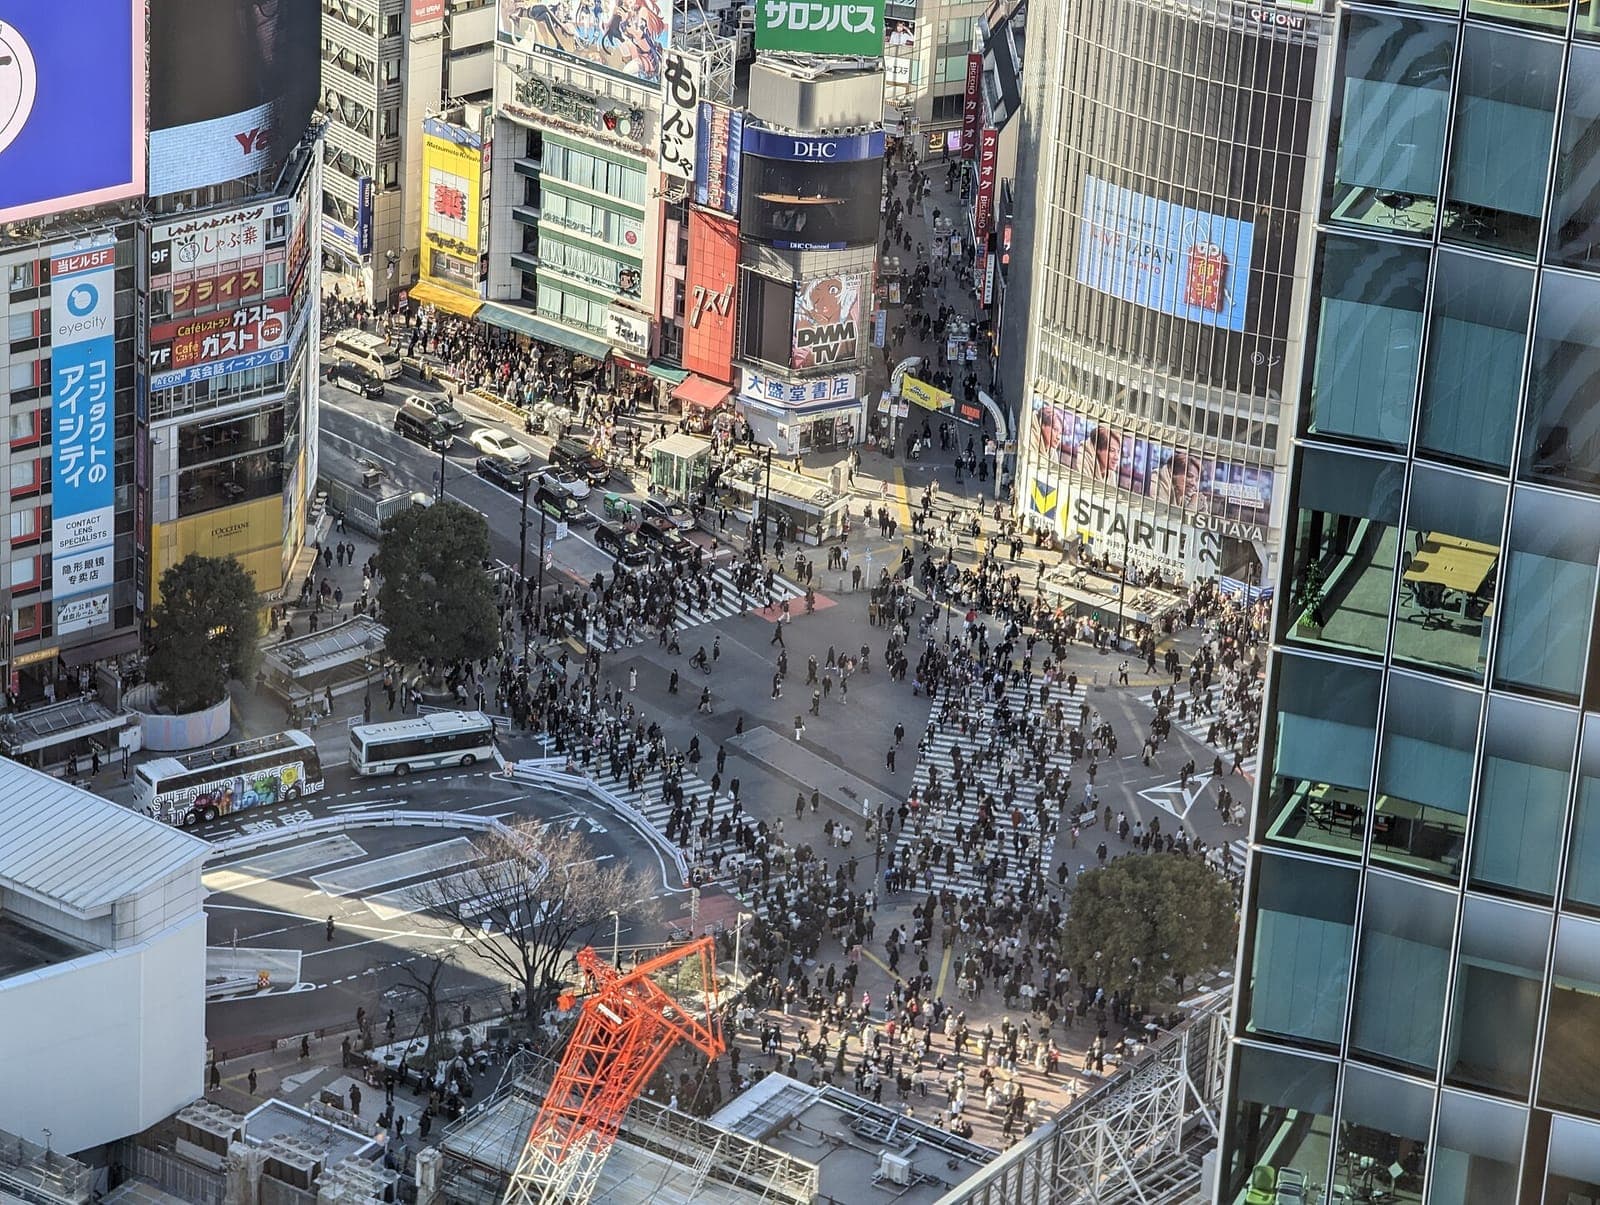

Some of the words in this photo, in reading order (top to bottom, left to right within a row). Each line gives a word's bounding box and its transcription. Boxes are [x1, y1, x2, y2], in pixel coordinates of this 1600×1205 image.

[765, 1, 875, 34] サロンパス
[1251, 9, 1303, 29] QFRONT
[661, 55, 697, 176] もんじゃ
[963, 101, 977, 152] カラオケ
[793, 141, 837, 158] DHC
[981, 136, 995, 190] カラオケ
[168, 206, 265, 237] しゃぶしゃぶバイキング
[203, 226, 258, 253] しゃぶ葉
[57, 251, 108, 273] 当ビル5F
[151, 248, 169, 264] 9F
[173, 271, 259, 306] プライス
[233, 304, 274, 326] ガスト
[689, 283, 734, 328] クスリ
[58, 316, 107, 337] eyecity
[264, 327, 281, 337] ガスト
[798, 321, 855, 348] DMM
[151, 348, 171, 365] 7F
[201, 328, 254, 359] ガスト
[813, 342, 840, 364] TV
[156, 373, 183, 386] AEON
[190, 354, 266, 381] 英会話イーオン
[748, 375, 849, 402] 大盛堂書店
[59, 364, 85, 488] アイシティ
[88, 360, 107, 483] コンタクトの
[65, 515, 101, 530] CONTACT
[73, 526, 93, 536] LENS
[1073, 498, 1188, 559] START!
[1184, 513, 1263, 542] TSUTAYA
[59, 530, 107, 548] SPECIALISTS
